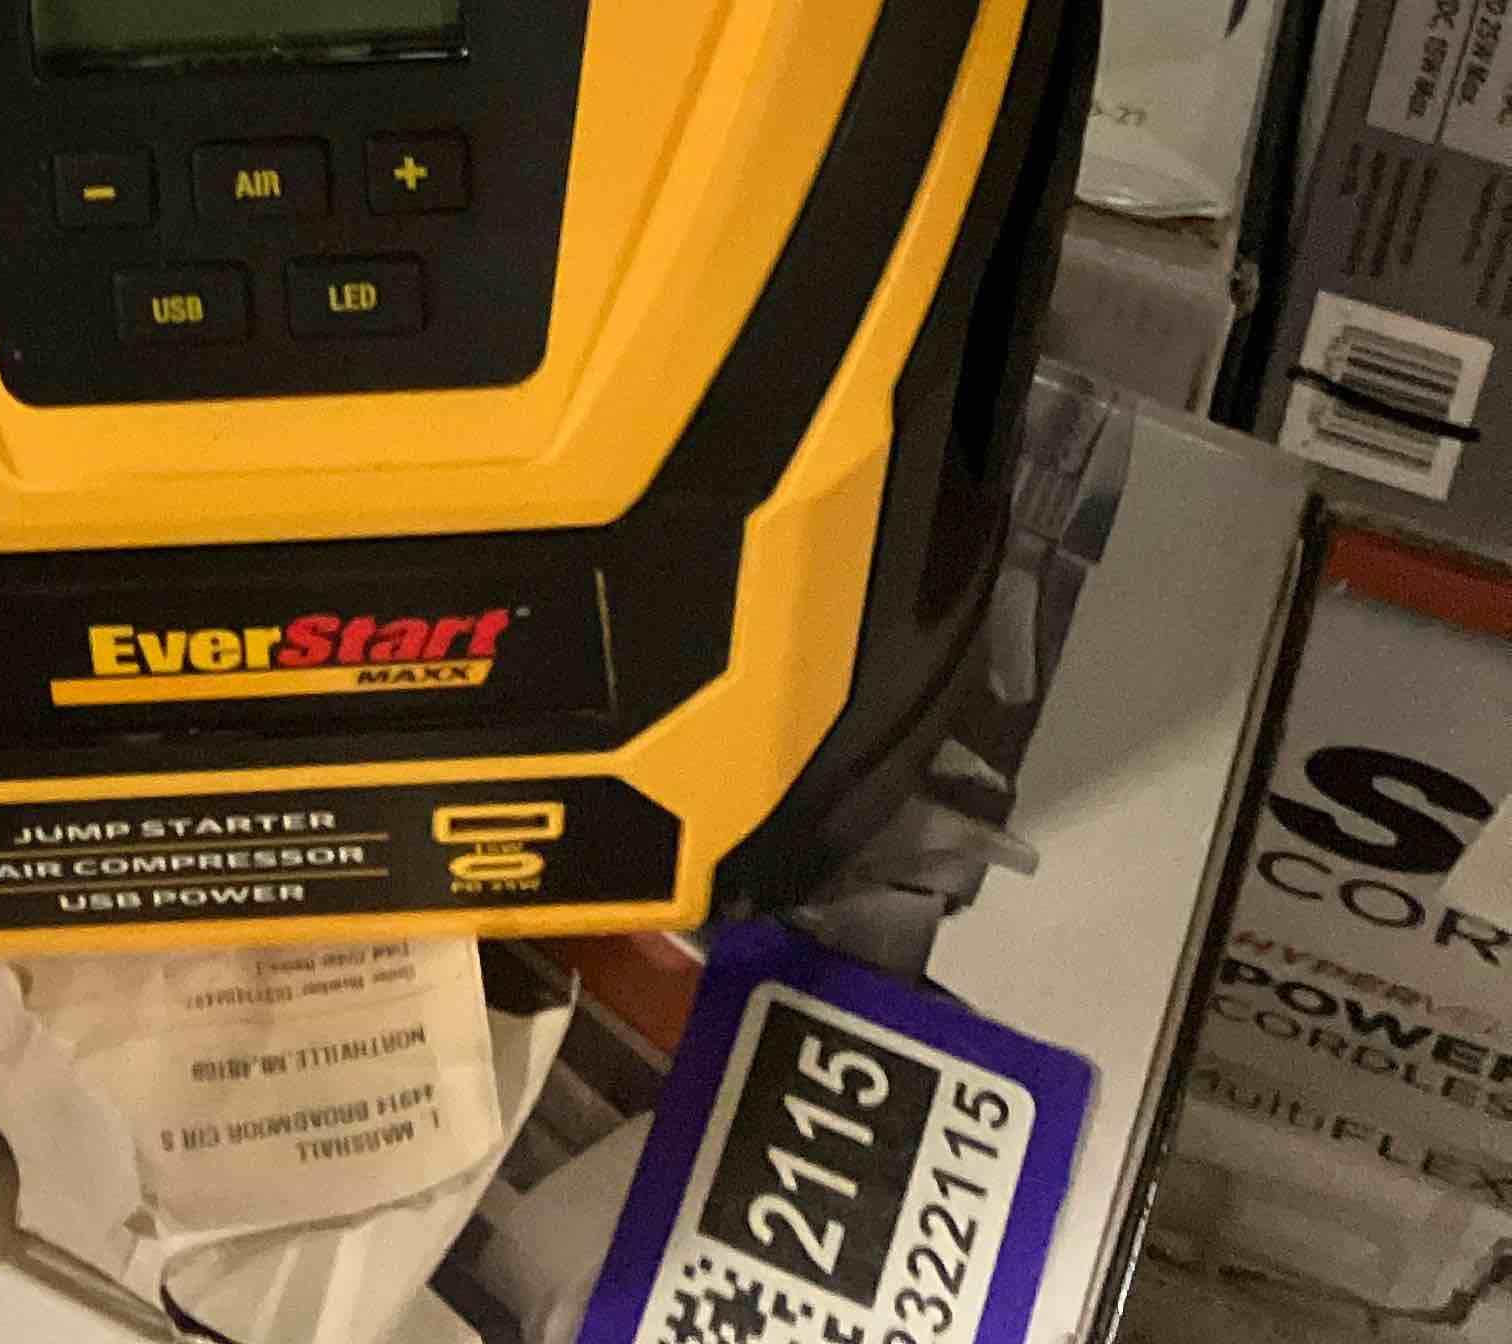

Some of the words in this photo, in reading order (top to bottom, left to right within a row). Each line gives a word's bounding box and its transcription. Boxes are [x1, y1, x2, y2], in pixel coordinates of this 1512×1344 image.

[234, 169, 282, 198] AIR
[151, 295, 204, 324] USB
[328, 283, 377, 313] LED
[88, 608, 511, 675] EverStart
[356, 662, 474, 686] MAXX
[13, 820, 132, 845] JUMP
[139, 810, 338, 839] STARTER
[73, 842, 367, 878] COMPRESSOR
[58, 889, 144, 913] USB
[151, 881, 306, 909] POWER
[736, 1026, 900, 1276] 2115
